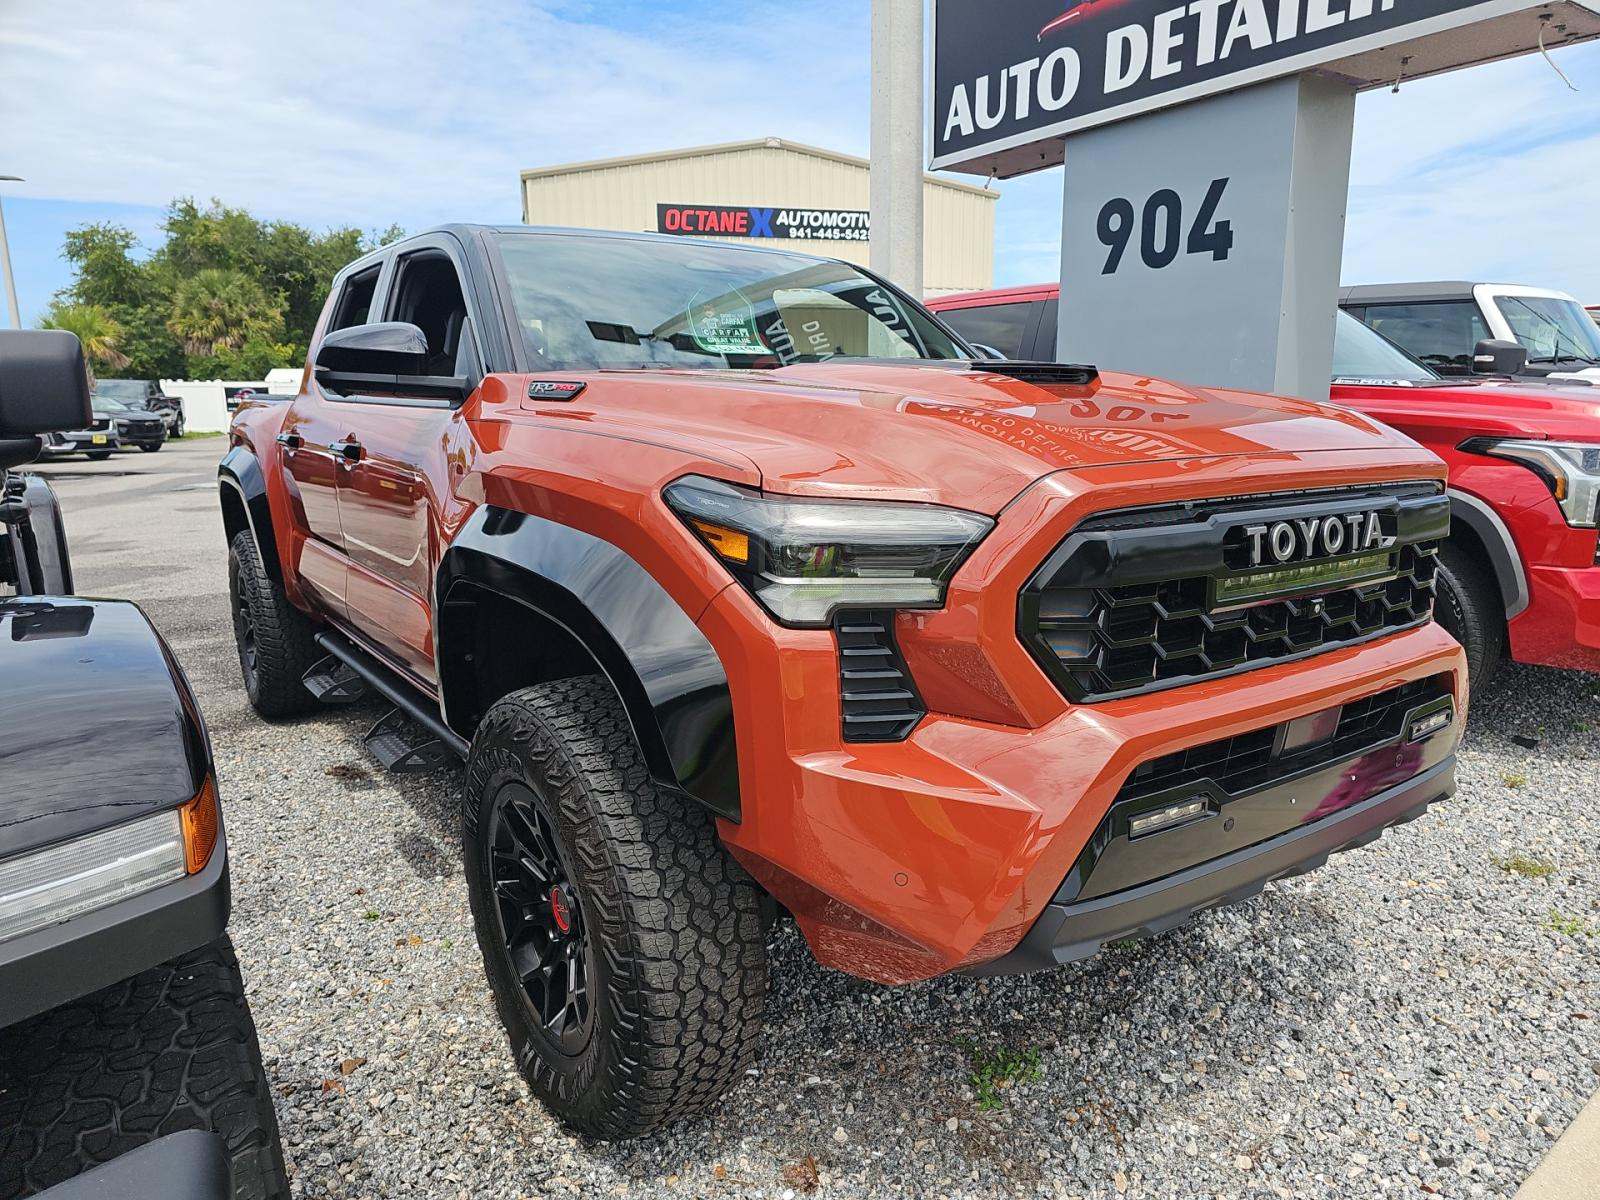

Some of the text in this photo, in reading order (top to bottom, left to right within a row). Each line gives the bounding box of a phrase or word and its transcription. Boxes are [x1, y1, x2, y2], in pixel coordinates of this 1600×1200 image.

[943, 0, 1394, 141] AUTO DETAIL
[665, 208, 747, 232] OCTANE
[776, 210, 870, 228] AUTOMOTIV
[789, 227, 870, 240] 941-445-542
[1097, 177, 1233, 275] 904
[1244, 511, 1384, 563] TOYOTA
